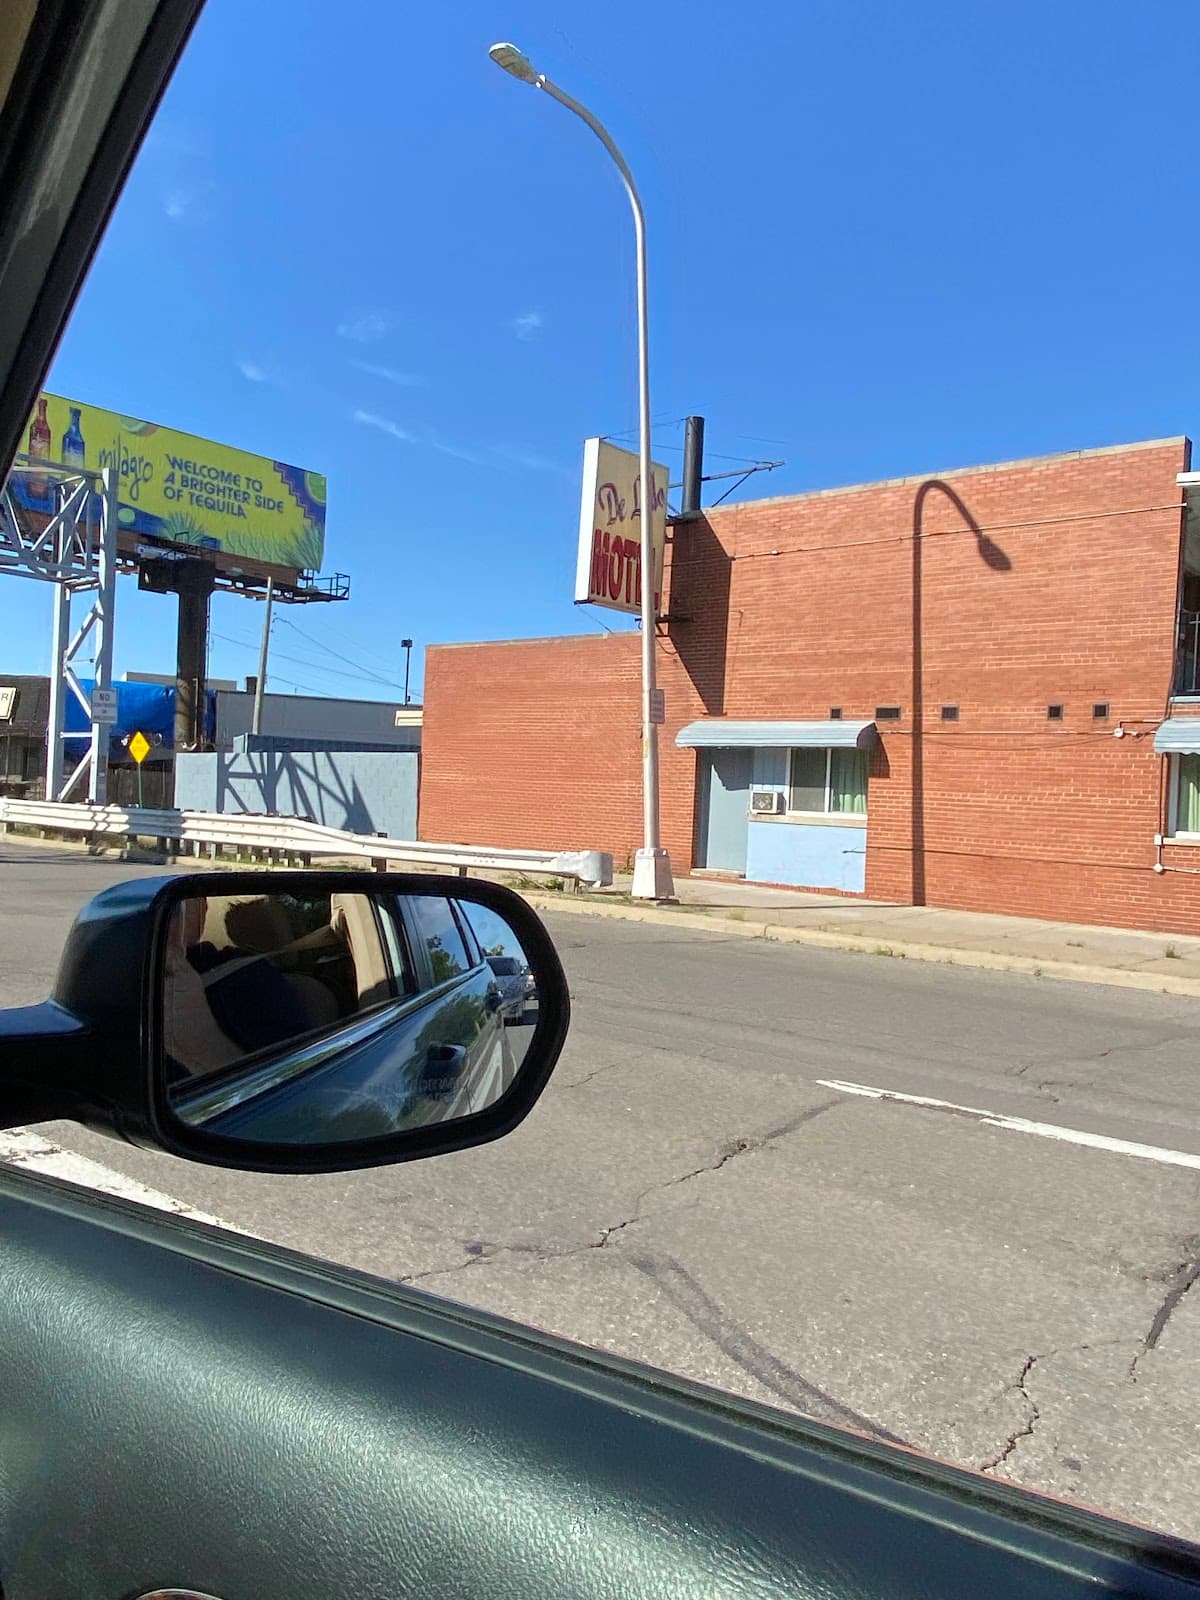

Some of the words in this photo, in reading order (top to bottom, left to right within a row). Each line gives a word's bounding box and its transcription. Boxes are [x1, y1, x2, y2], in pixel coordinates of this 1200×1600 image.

[98, 432, 154, 502] milagro
[165, 454, 241, 487] WELCOME
[245, 477, 263, 492] TO
[164, 471, 176, 485] A
[181, 474, 250, 505] BRIGHTER
[255, 494, 284, 513] SIDE
[164, 486, 183, 501] OF
[189, 491, 247, 519] TEQUILA
[99, 693, 111, 701] NO
